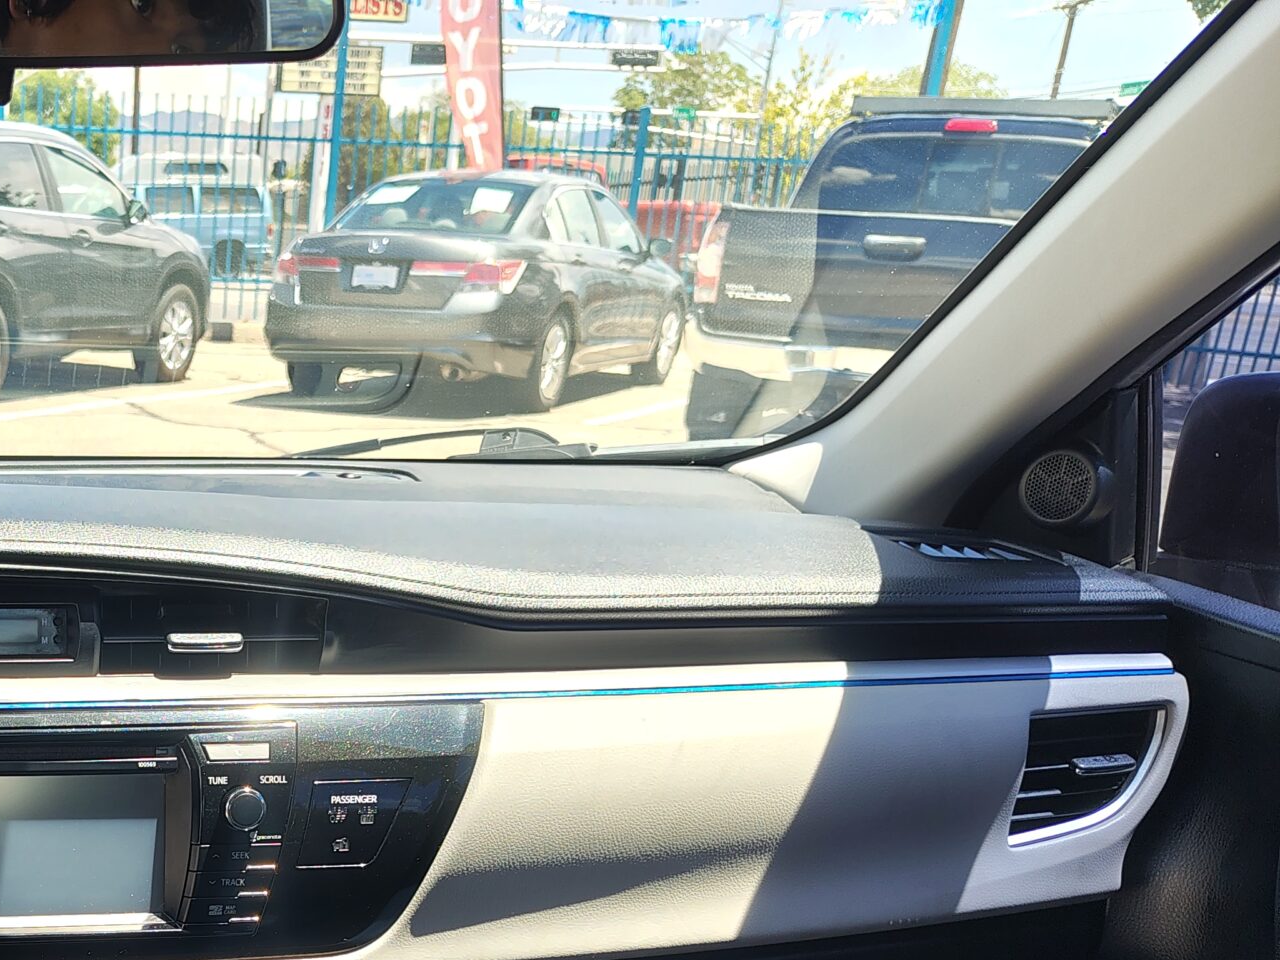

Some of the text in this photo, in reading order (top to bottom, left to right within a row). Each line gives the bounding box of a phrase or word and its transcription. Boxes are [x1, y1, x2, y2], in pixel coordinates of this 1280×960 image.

[41, 618, 48, 626] H
[208, 777, 228, 785] TUNE
[260, 775, 287, 784] SCROLL
[331, 795, 378, 804] PASSENGER
[231, 851, 250, 859] SEEK
